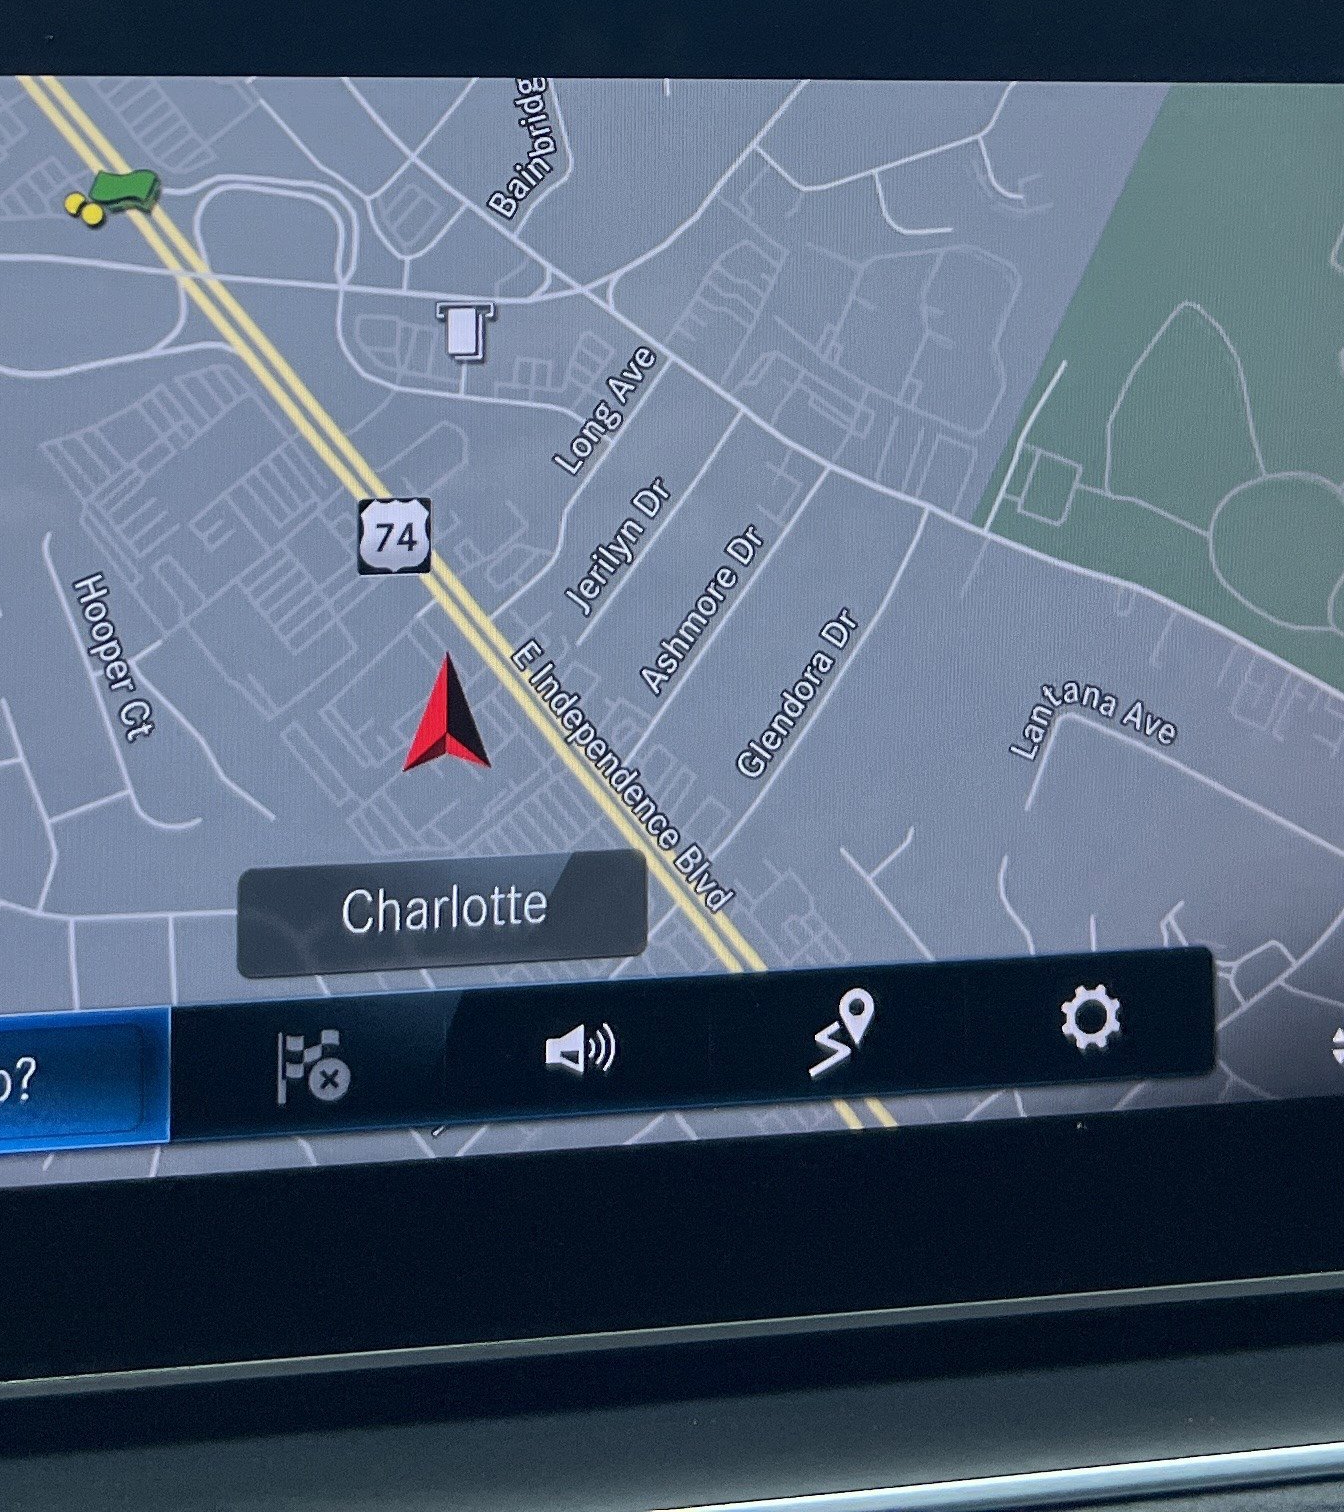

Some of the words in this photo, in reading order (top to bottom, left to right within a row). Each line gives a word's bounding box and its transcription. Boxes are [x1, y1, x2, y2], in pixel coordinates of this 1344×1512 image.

[553, 400, 624, 476] Long
[606, 345, 657, 405] Ave
[376, 522, 418, 553] 74
[564, 518, 645, 617] Jerilyn
[631, 477, 670, 518] Dr
[73, 573, 136, 692] Hooper
[119, 699, 155, 743] Ct
[640, 565, 739, 696] Ashmore
[725, 525, 764, 566] Dr
[736, 650, 835, 779] Glendora
[819, 607, 858, 650] Dr
[1009, 680, 1118, 763] Lantana
[1121, 700, 1177, 746] Ave
[511, 639, 544, 672] E
[529, 661, 681, 850] Independence
[673, 842, 735, 914] Blvd
[341, 883, 549, 935] Charlotte
